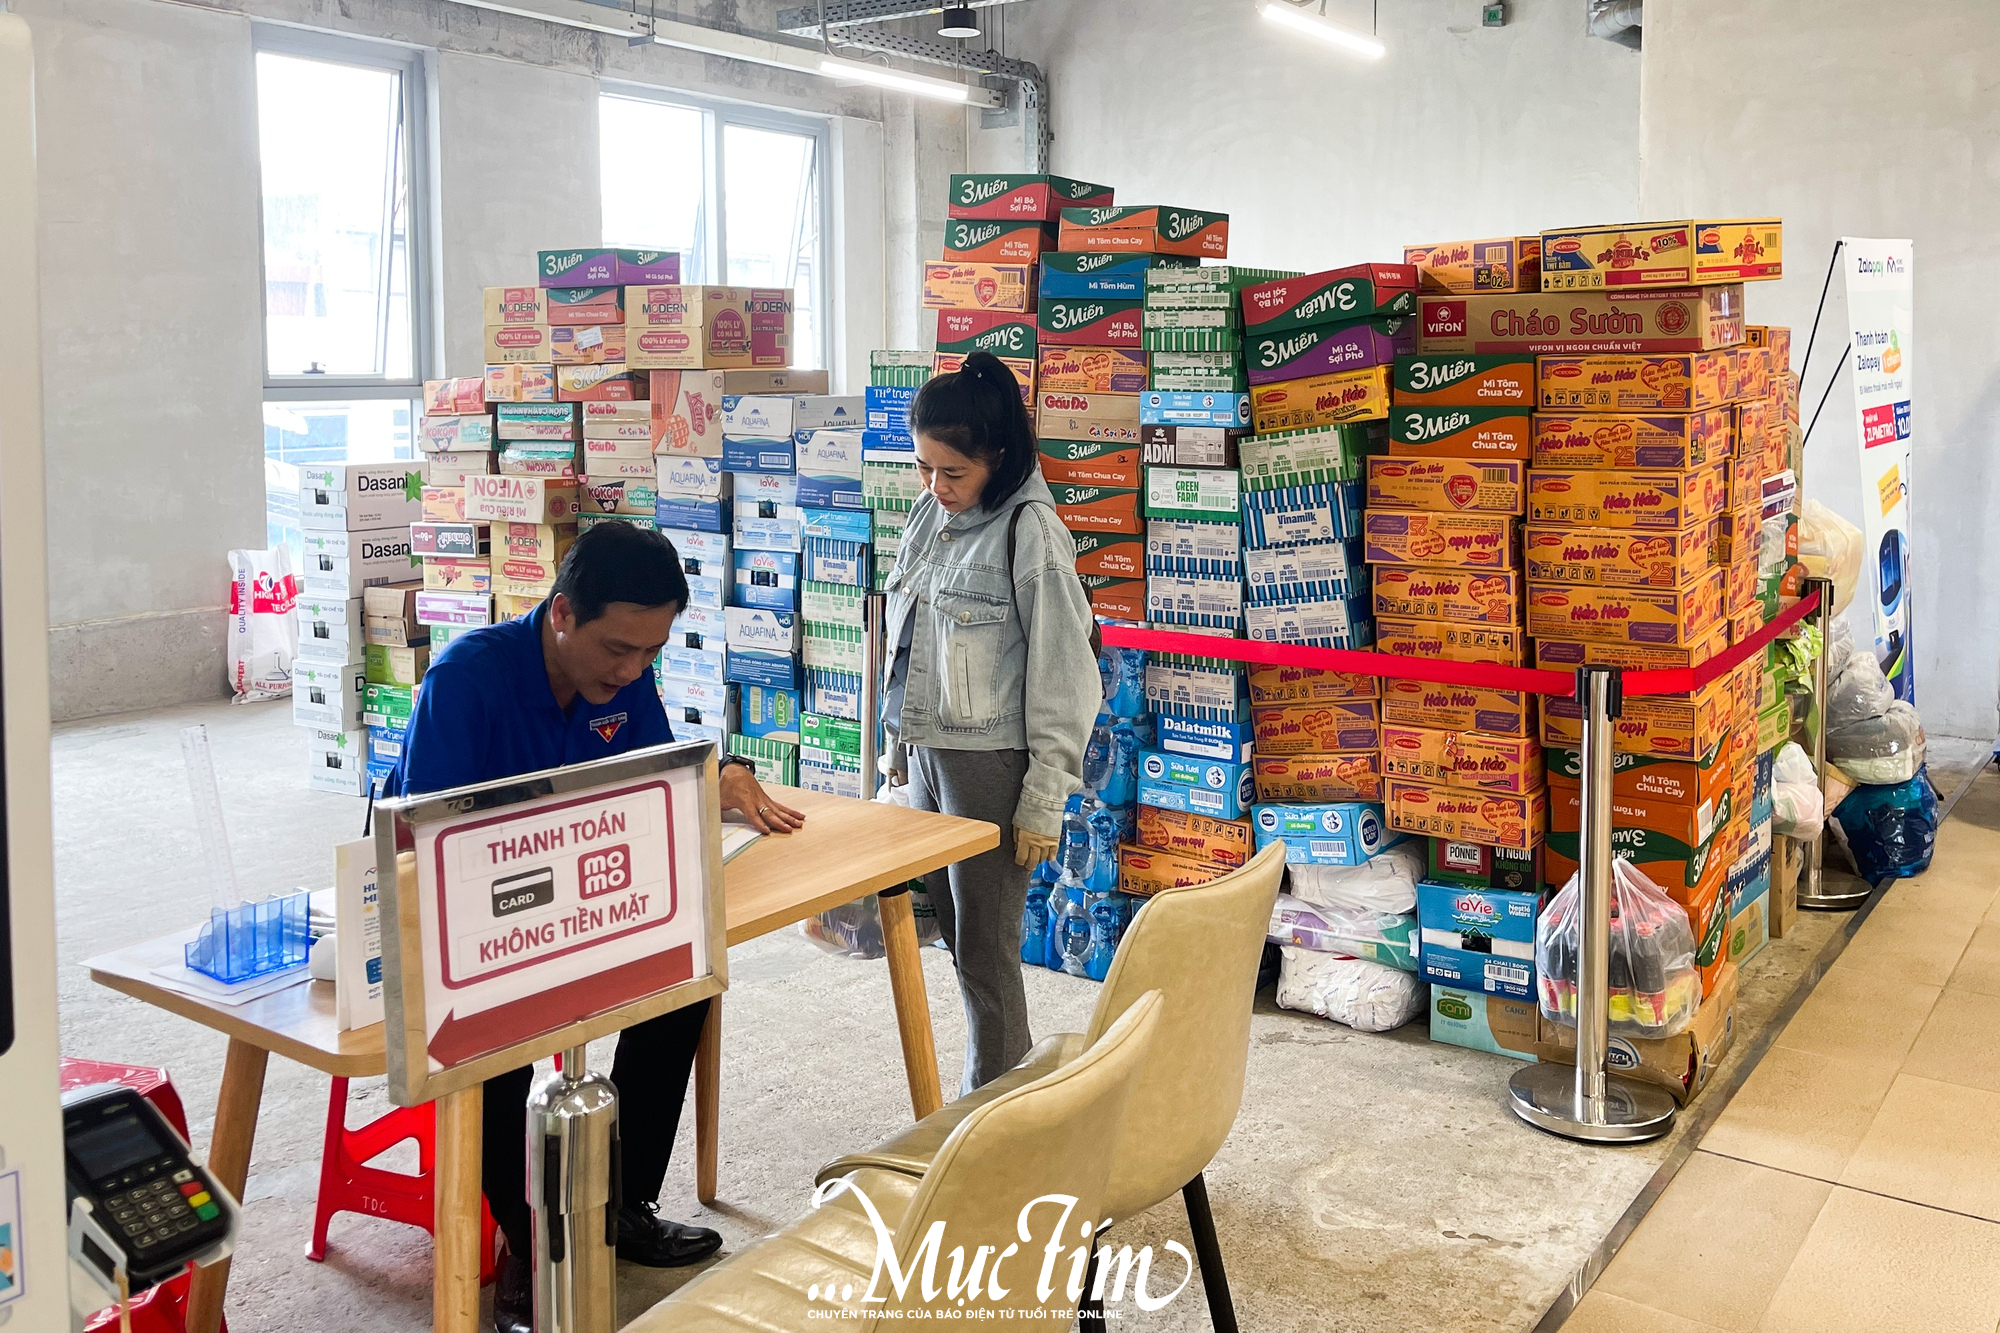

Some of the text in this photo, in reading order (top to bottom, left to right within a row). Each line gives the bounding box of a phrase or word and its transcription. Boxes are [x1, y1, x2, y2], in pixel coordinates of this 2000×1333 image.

[1025, 196, 1034, 204] Bò
[1010, 202, 1037, 212] Sợi Phở
[1014, 241, 1029, 250] Tôm
[1130, 238, 1143, 246] Cay
[1657, 236, 1677, 247] 10%
[999, 249, 1031, 258] Chua Cay
[1858, 258, 1883, 277] Zalopay
[1089, 281, 1135, 290] Mì Tôm Hùm
[499, 302, 540, 313] MODERN
[642, 302, 688, 314] MODERN
[745, 301, 791, 313] MODERN
[717, 320, 741, 329] 100% LY
[1112, 321, 1134, 330] Mì Bò
[1428, 322, 1462, 333] VIFON
[1491, 307, 1643, 337] Cháo Sườn
[1108, 328, 1138, 340] Sợi Phở
[1855, 330, 1888, 347] Thanh toán
[1332, 343, 1358, 354] Mì Gà
[1592, 341, 1620, 350] CHUẨN
[1623, 342, 1641, 350] VIỆT
[1328, 350, 1364, 364] Sợi Phở
[1858, 355, 1880, 372] Zalopay
[1483, 379, 1518, 388] Mì Tôm
[1477, 388, 1523, 399] Chua Cay
[588, 403, 616, 415] Gấu Đỏ
[1044, 395, 1089, 412] Gấu Đỏ
[741, 417, 770, 428] AQUAFINA
[426, 427, 458, 439] KOKOMI
[1478, 432, 1513, 441] Mì Tôm
[588, 441, 616, 452] Gấu Đỏ
[1472, 441, 1518, 451] Chua Cay
[817, 449, 847, 461] AQUAFINA
[1144, 444, 1174, 464] ADM
[358, 473, 408, 491] Dasani
[670, 473, 706, 486] AQUAFINA
[1078, 471, 1091, 479] Tôm
[1093, 472, 1109, 480] Chua
[1111, 472, 1125, 481] Cay
[474, 478, 523, 498] VIFON
[1176, 481, 1199, 492] GREEN
[588, 488, 624, 500] KOKOMI
[1177, 492, 1198, 502] FARM
[1603, 490, 1662, 510] Hảo Hảo
[480, 504, 526, 516] Mì Riêu Cua
[603, 502, 615, 512] 90
[1074, 515, 1087, 523] Tôm
[1089, 515, 1106, 524] Chua
[1107, 516, 1122, 525] Cay
[1278, 512, 1316, 525] Vinamilk
[505, 536, 542, 547] MODERN
[1562, 542, 1619, 561] Hảo Hảo
[1116, 554, 1131, 562] Tôm
[1100, 561, 1134, 572] Chua Cay
[1409, 580, 1461, 597] Hảo Hảo
[1570, 602, 1630, 621] Hảo Hảo
[740, 624, 778, 640] AQUAFINA
[1423, 690, 1477, 707] Hảo Hảo
[1164, 718, 1232, 739] Dalatmilk
[1171, 762, 1199, 773] Sữa Tươi
[1657, 777, 1680, 787] Tôm
[1636, 783, 1684, 798] Chua Cay
[488, 811, 626, 864] THANH TOÁN
[499, 893, 535, 911] CARD
[479, 893, 649, 963] KHÔNG TIỀN MẶT
[1505, 1006, 1527, 1015] CANXI
[363, 1196, 387, 1213] TDC
